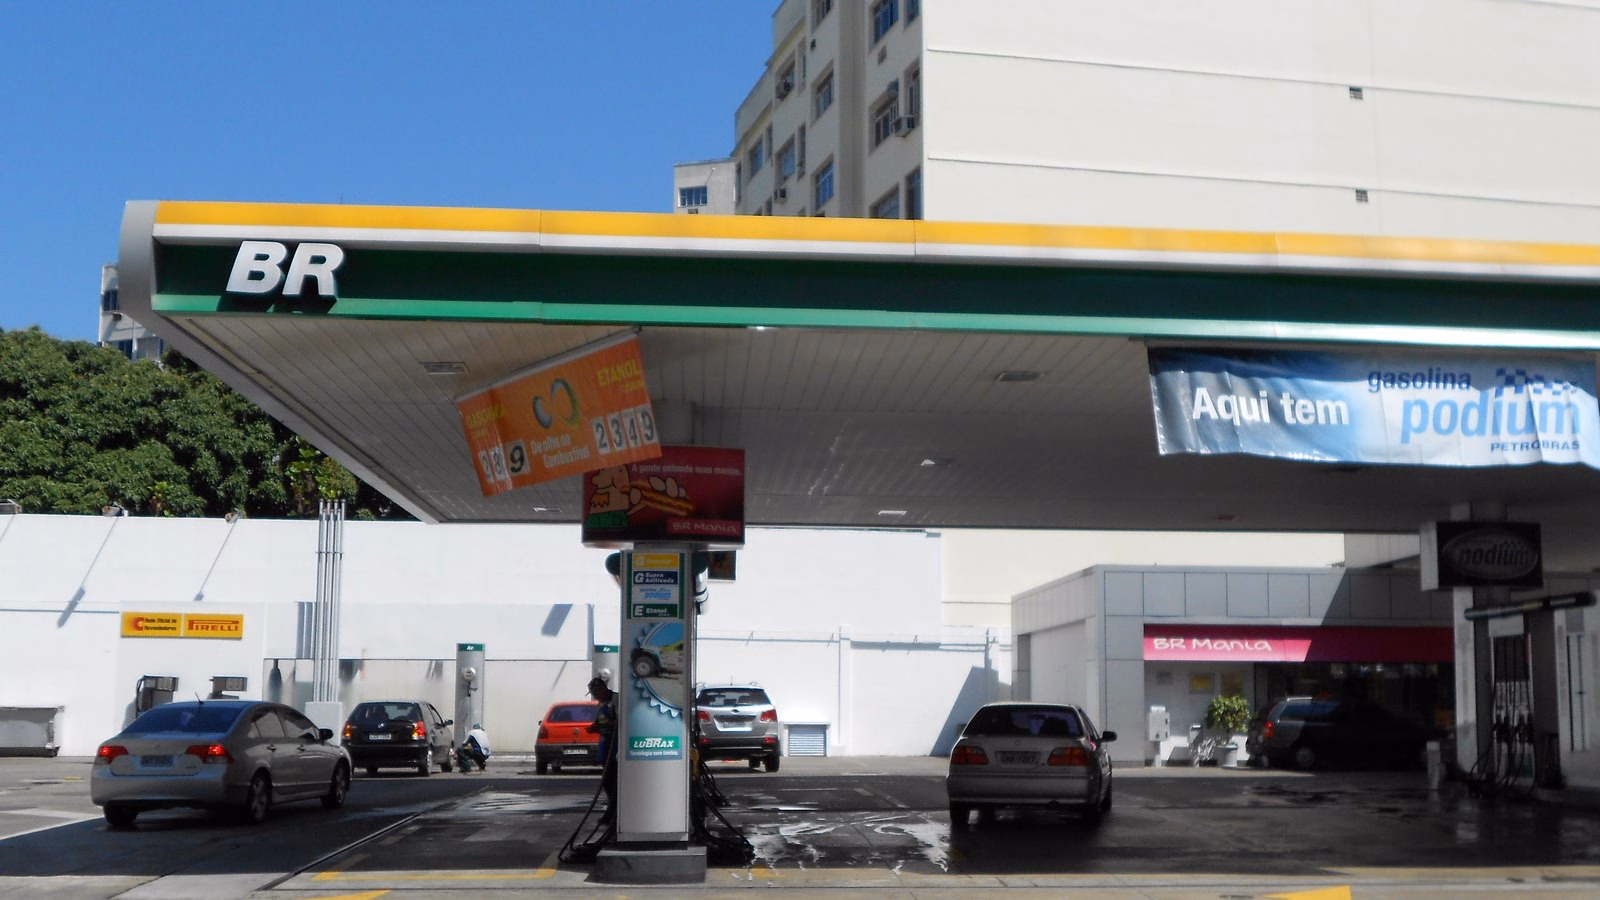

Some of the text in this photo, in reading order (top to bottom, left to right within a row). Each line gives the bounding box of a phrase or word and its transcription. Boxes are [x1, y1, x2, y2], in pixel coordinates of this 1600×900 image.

[226, 241, 344, 295] BR
[597, 358, 640, 386] ETANOL
[1367, 367, 1472, 393] gasolina
[1192, 387, 1350, 427] Aqui tem
[1401, 391, 1580, 444] podium
[1490, 439, 1580, 452] PETROBRAS
[631, 464, 638, 472] A
[640, 464, 660, 474] gente
[662, 465, 693, 474] entende
[634, 572, 645, 583] G
[634, 605, 644, 616] E
[188, 619, 240, 631] PIRELLI
[1153, 637, 1272, 651] BR Mania
